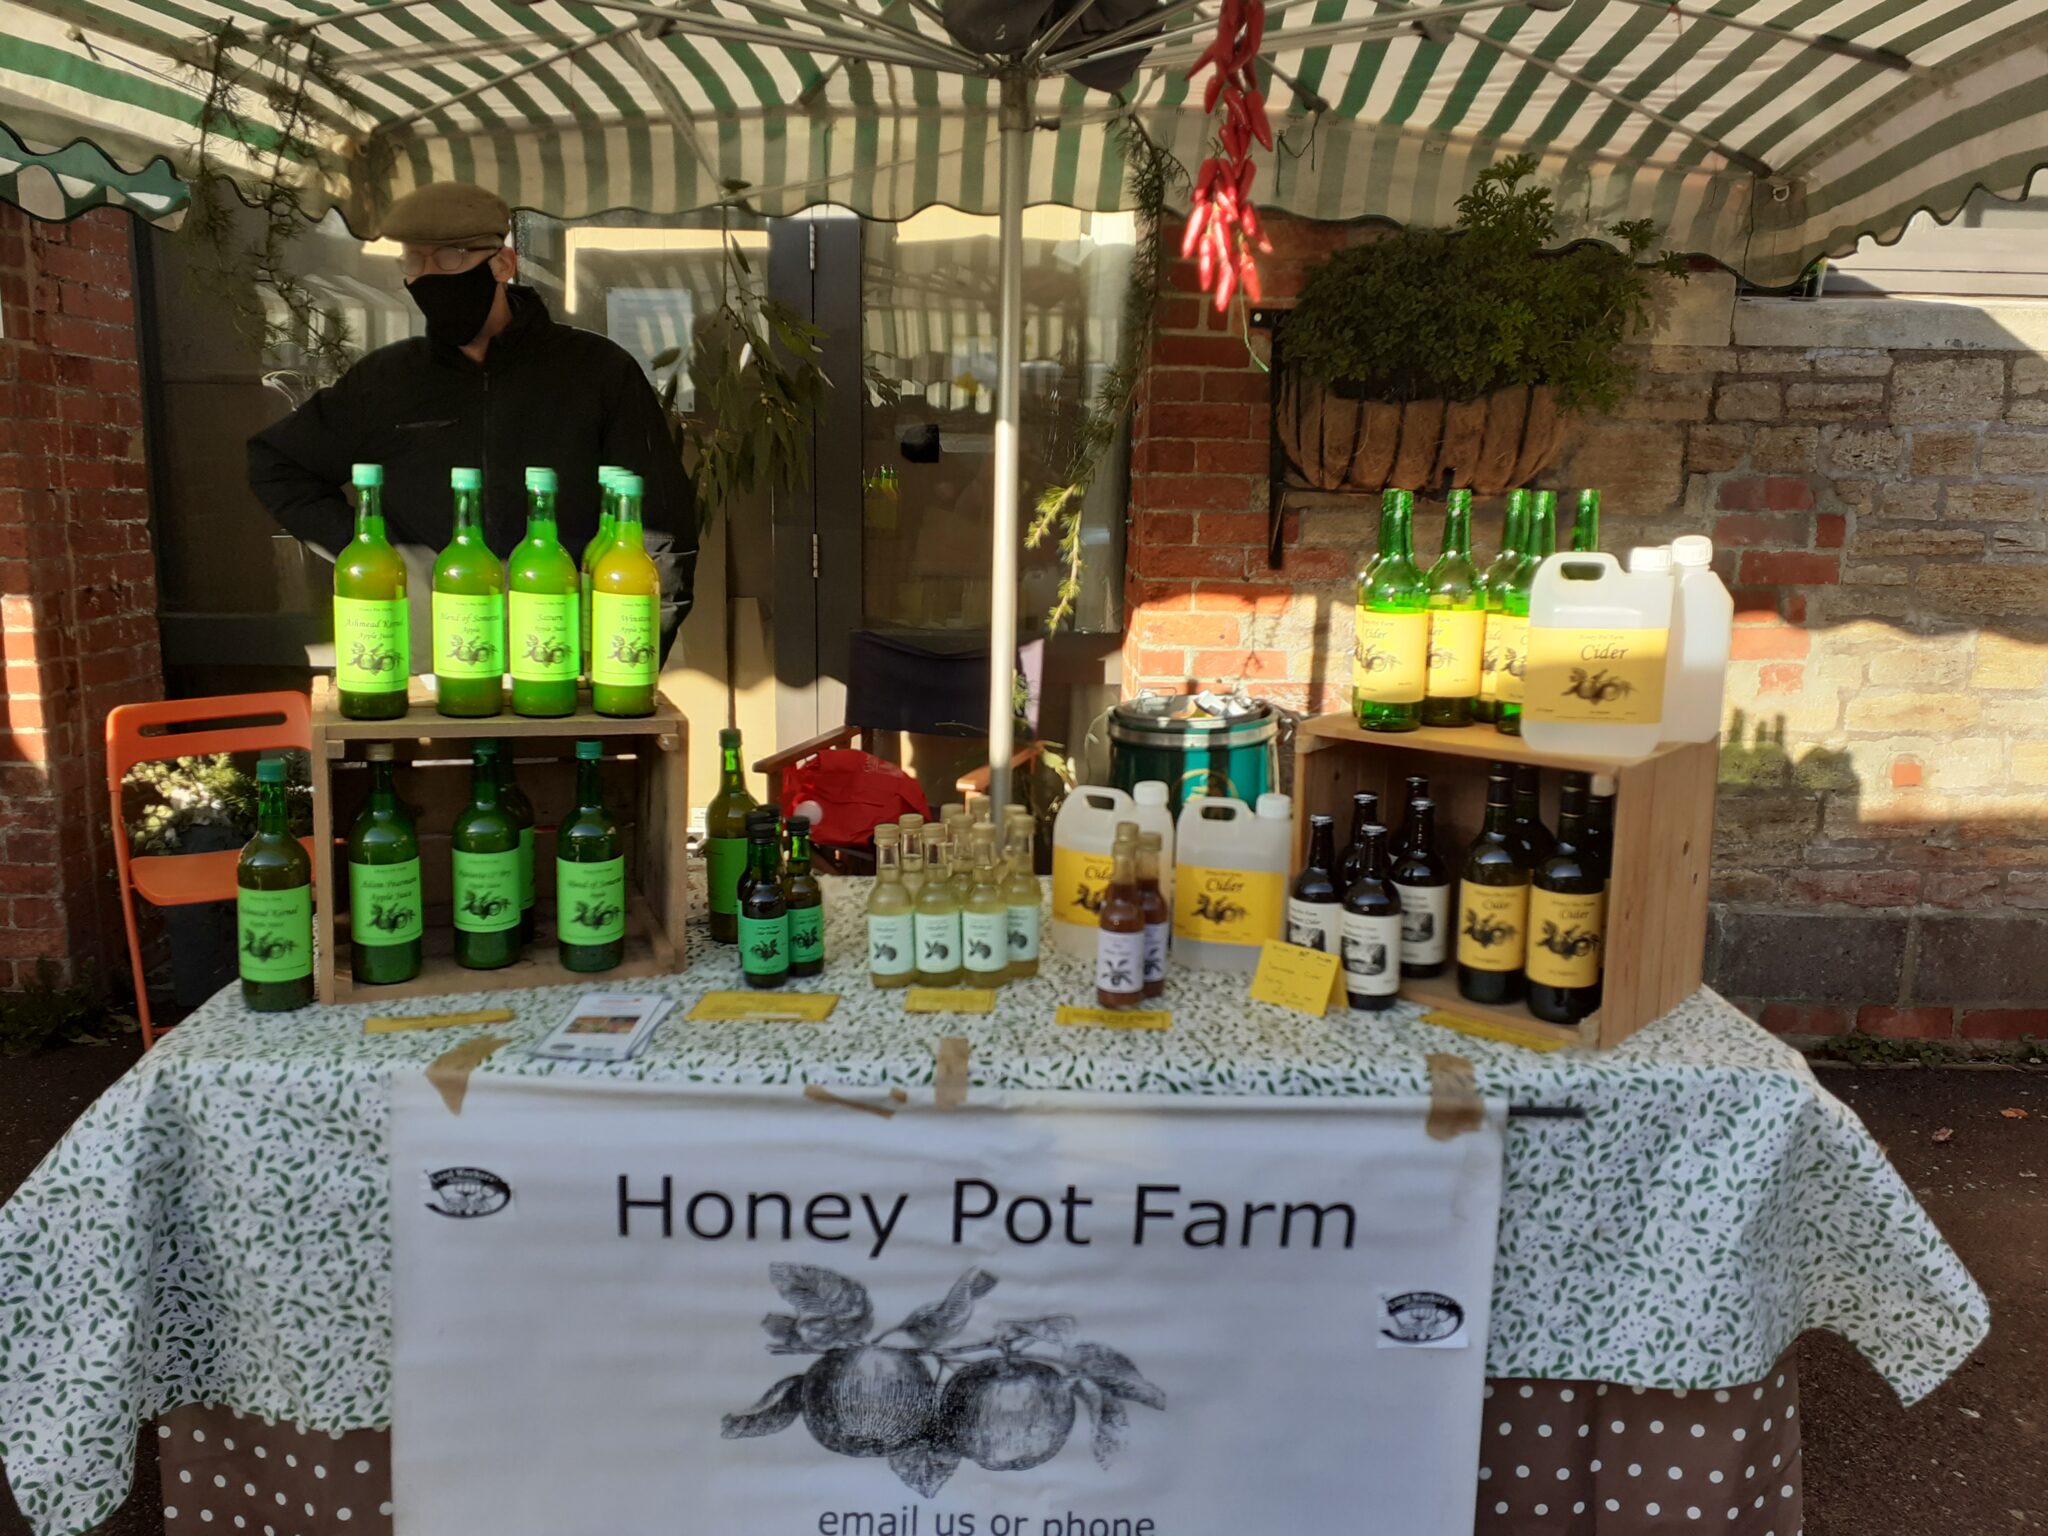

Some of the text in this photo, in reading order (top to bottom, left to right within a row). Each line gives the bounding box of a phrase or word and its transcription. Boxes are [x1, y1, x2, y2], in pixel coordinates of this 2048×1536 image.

[1580, 642, 1630, 661] Cider
[1205, 873, 1246, 893] Cider
[617, 1173, 1357, 1260] Honey Pot Farm
[818, 1505, 1155, 1536] email us or phone
